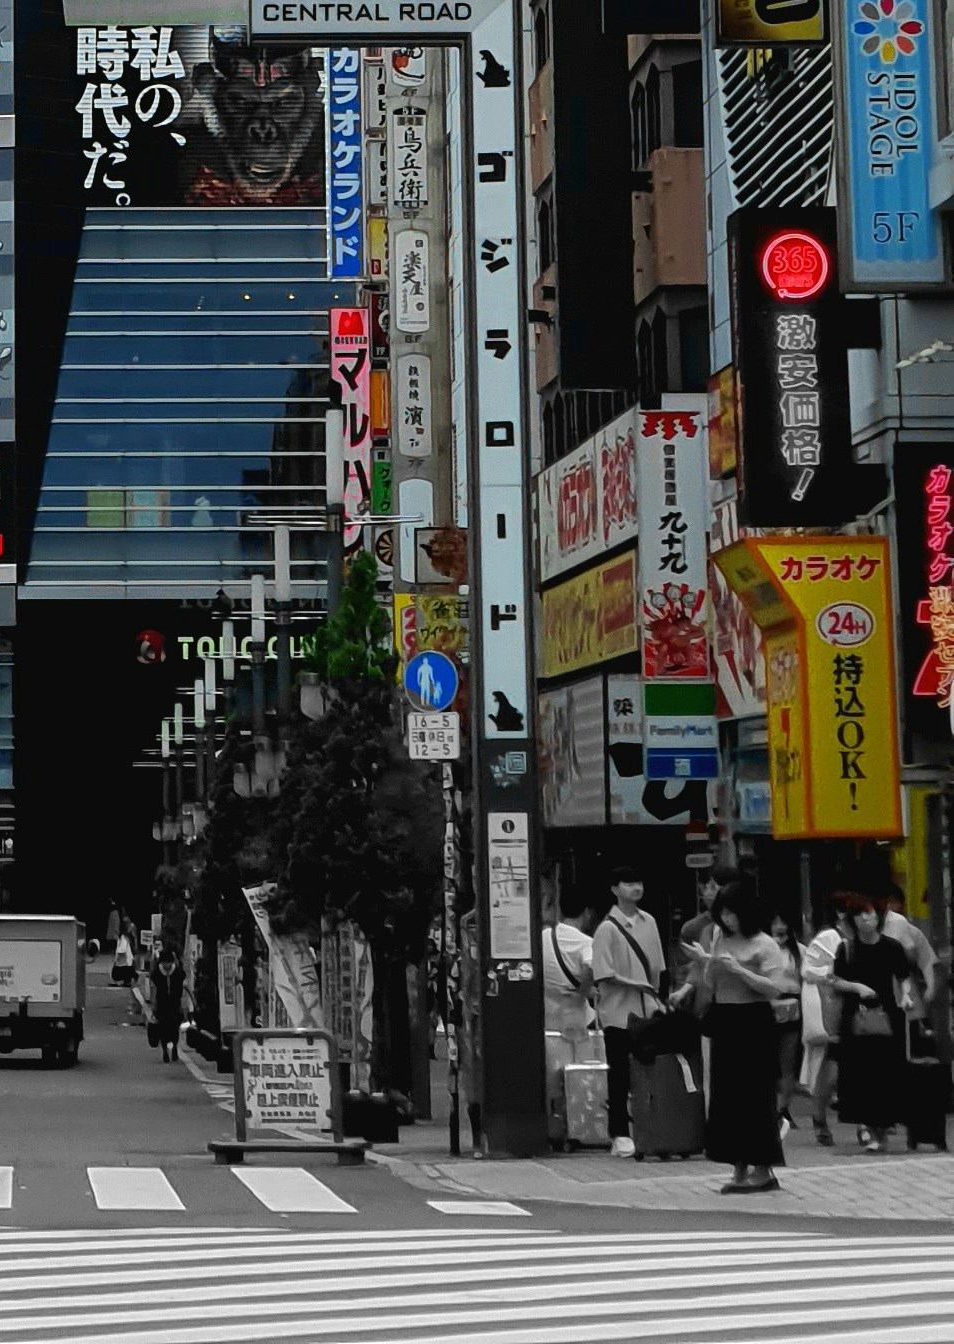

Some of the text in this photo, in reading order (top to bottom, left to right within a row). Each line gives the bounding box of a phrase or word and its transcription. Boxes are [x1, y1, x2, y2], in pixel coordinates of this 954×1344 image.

[262, 2, 473, 23] CENTRAL ROAD
[74, 25, 132, 207] 時代だ。
[130, 25, 187, 147] 私の、
[867, 72, 895, 178] STAGE
[893, 72, 917, 161] IDOL
[331, 47, 361, 266] カラオケランド
[772, 245, 818, 274] 365
[872, 211, 920, 245] 5F
[477, 150, 516, 630] ゴジラロード
[776, 314, 822, 502] 激安価格!
[658, 511, 689, 575] 九十九
[779, 554, 881, 582] カラオケ
[926, 465, 952, 583] カラオケ
[827, 611, 867, 636] 24H
[833, 653, 868, 811] 持込OK!
